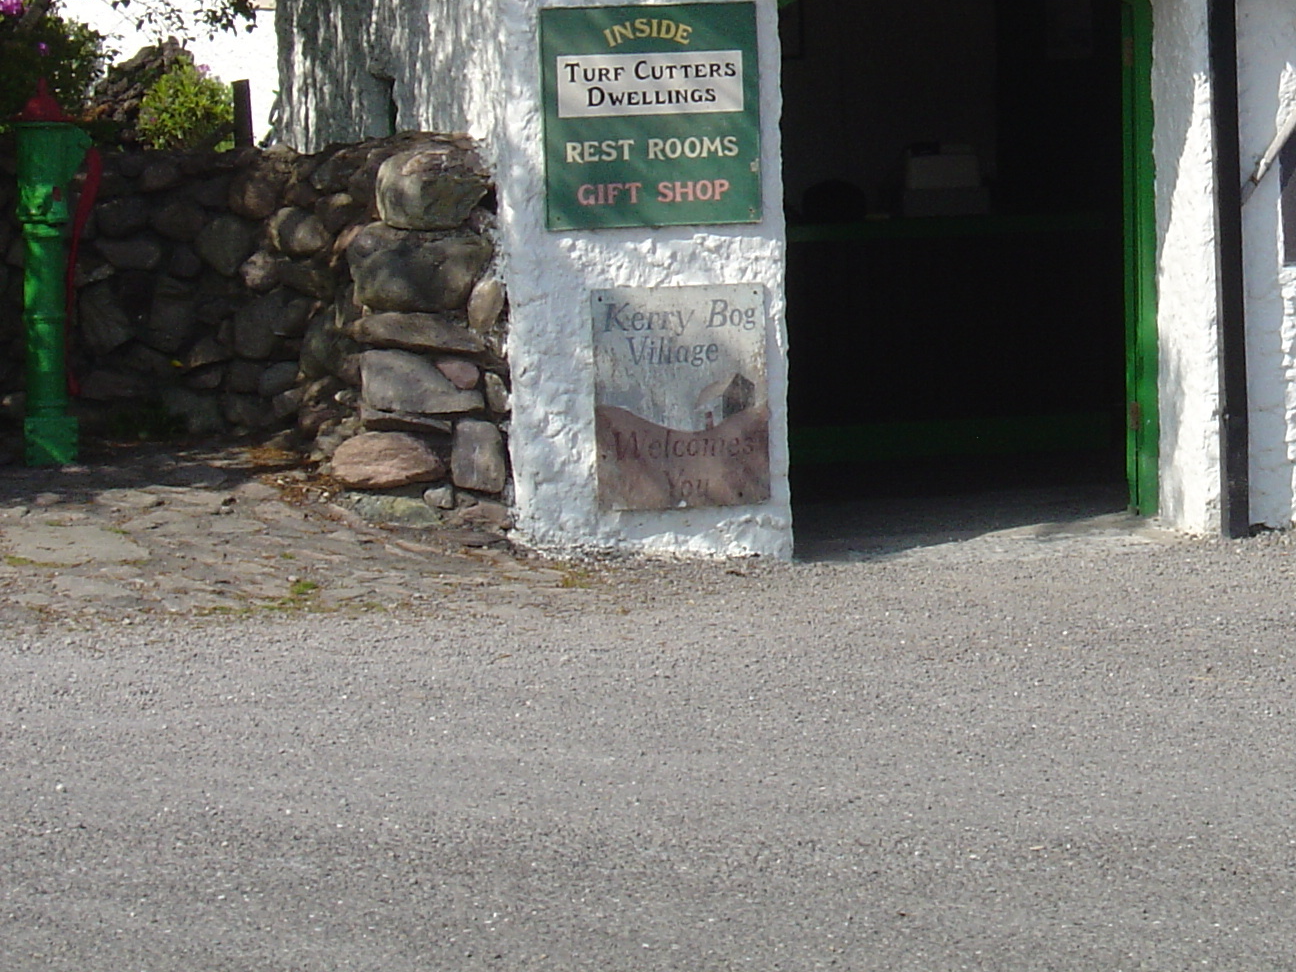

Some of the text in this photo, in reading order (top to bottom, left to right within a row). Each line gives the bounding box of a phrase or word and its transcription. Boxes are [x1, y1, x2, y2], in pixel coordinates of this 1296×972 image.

[603, 18, 693, 47] INSIDE
[566, 136, 739, 164] REST ROOMS
[577, 179, 730, 206] GIFT SHOP
[602, 299, 757, 336] Kerry Bog
[626, 336, 719, 367] Village
